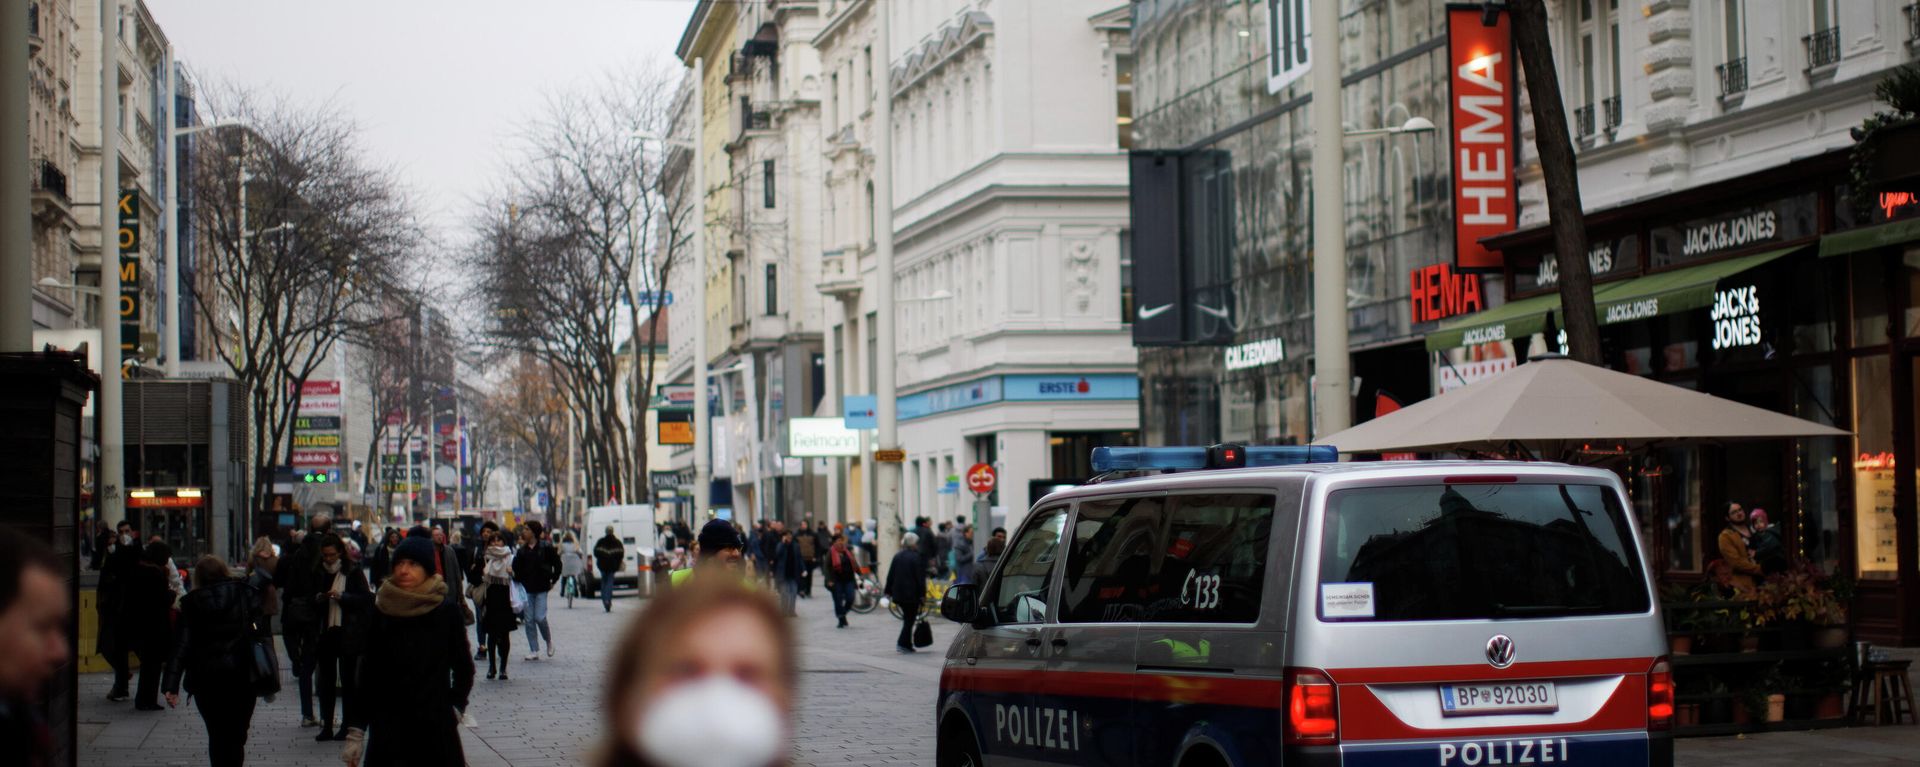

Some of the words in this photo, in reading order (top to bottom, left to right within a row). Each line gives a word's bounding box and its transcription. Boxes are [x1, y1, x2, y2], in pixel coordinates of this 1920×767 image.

[1458, 52, 1507, 225] HEMA
[1683, 210, 1776, 256] JACK&JONES
[1536, 246, 1612, 286] JACNES
[1410, 262, 1482, 325] HEMA
[1606, 298, 1658, 323] JACK&JONES
[1712, 314, 1761, 350] JONES
[1225, 337, 1284, 371] CALZEDONIA
[1040, 382, 1076, 393] ERSTE
[1195, 574, 1220, 609] 133
[1458, 687, 1479, 706] BP
[1493, 685, 1548, 704] 92030
[995, 703, 1079, 751] POLIZEI
[1440, 738, 1568, 767] POLIZEI
